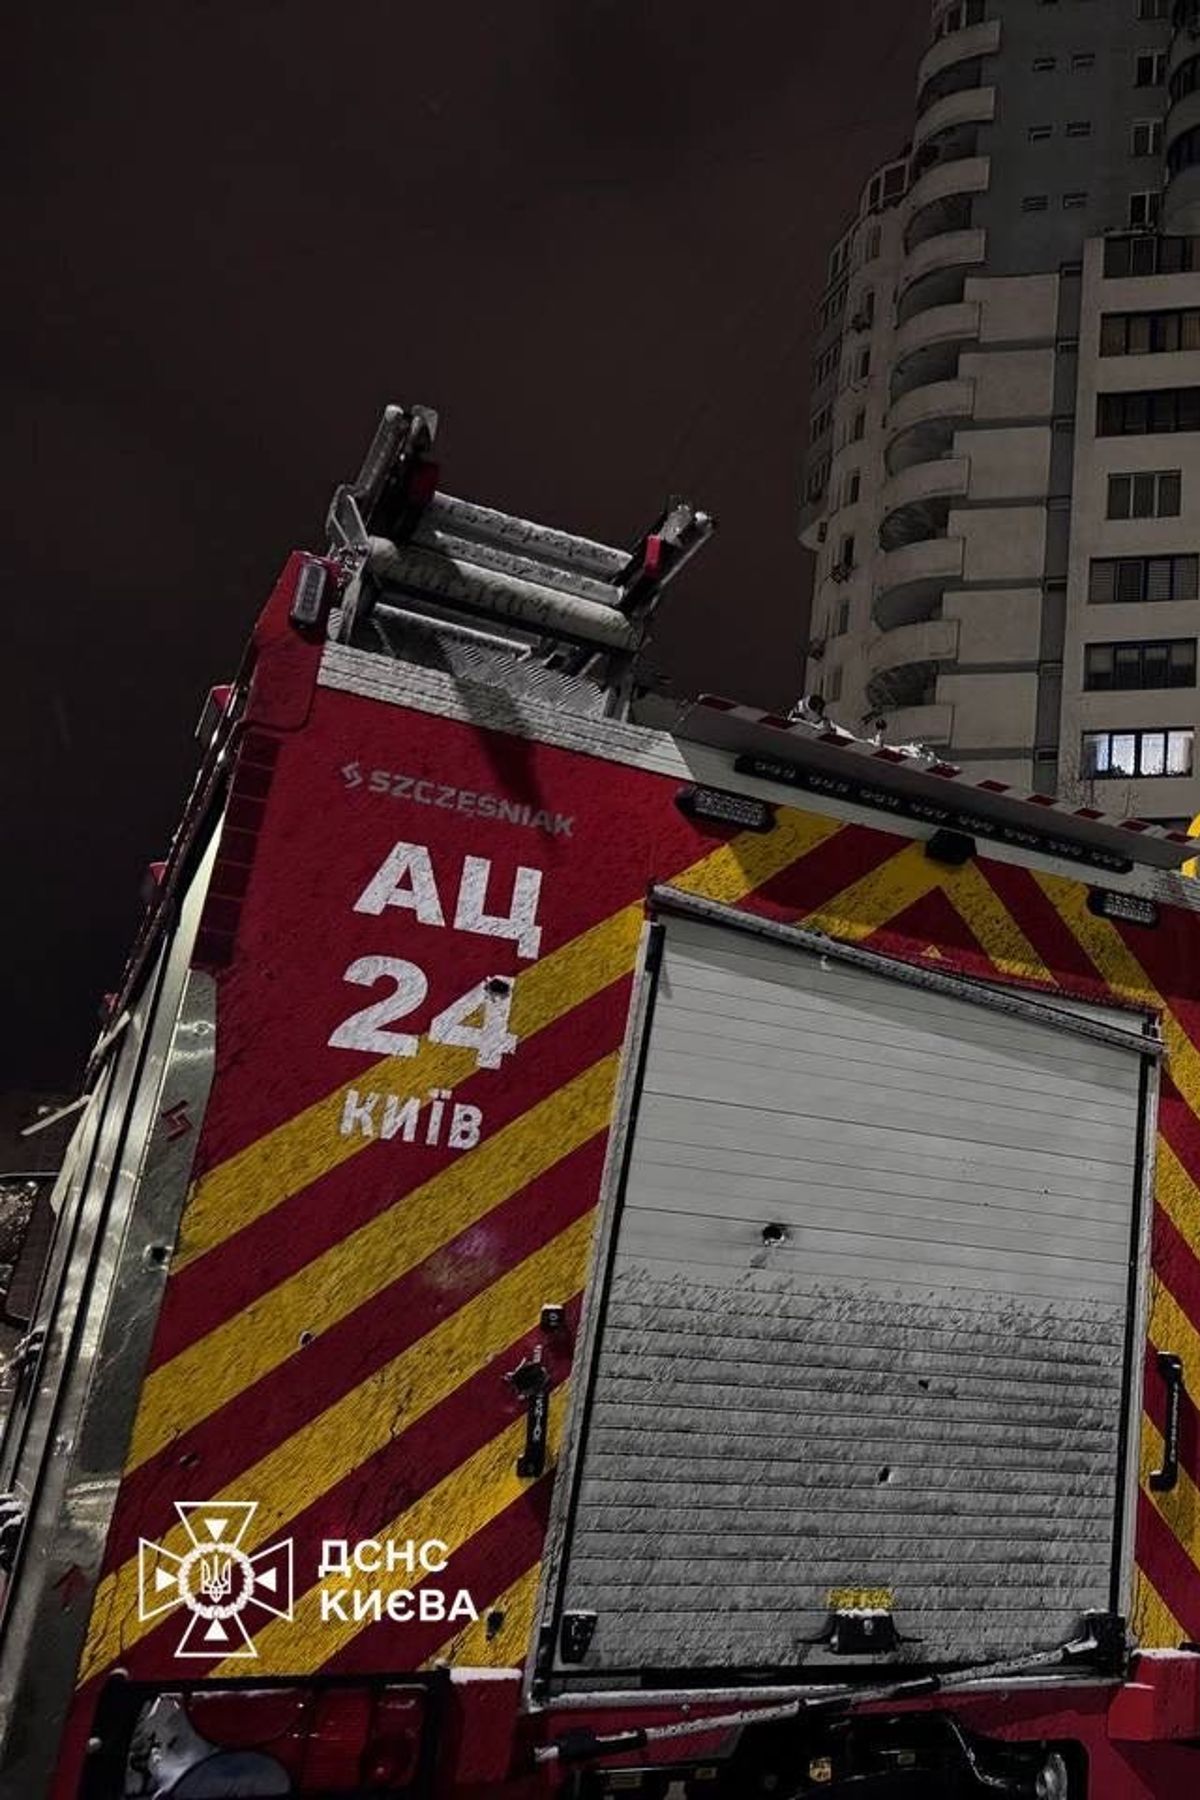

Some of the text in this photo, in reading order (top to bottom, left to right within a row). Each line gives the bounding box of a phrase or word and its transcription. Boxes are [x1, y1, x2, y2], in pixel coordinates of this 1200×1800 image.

[353, 841, 543, 959] АЦ
[328, 955, 517, 1070] 24
[338, 1089, 484, 1150] КИЇВ
